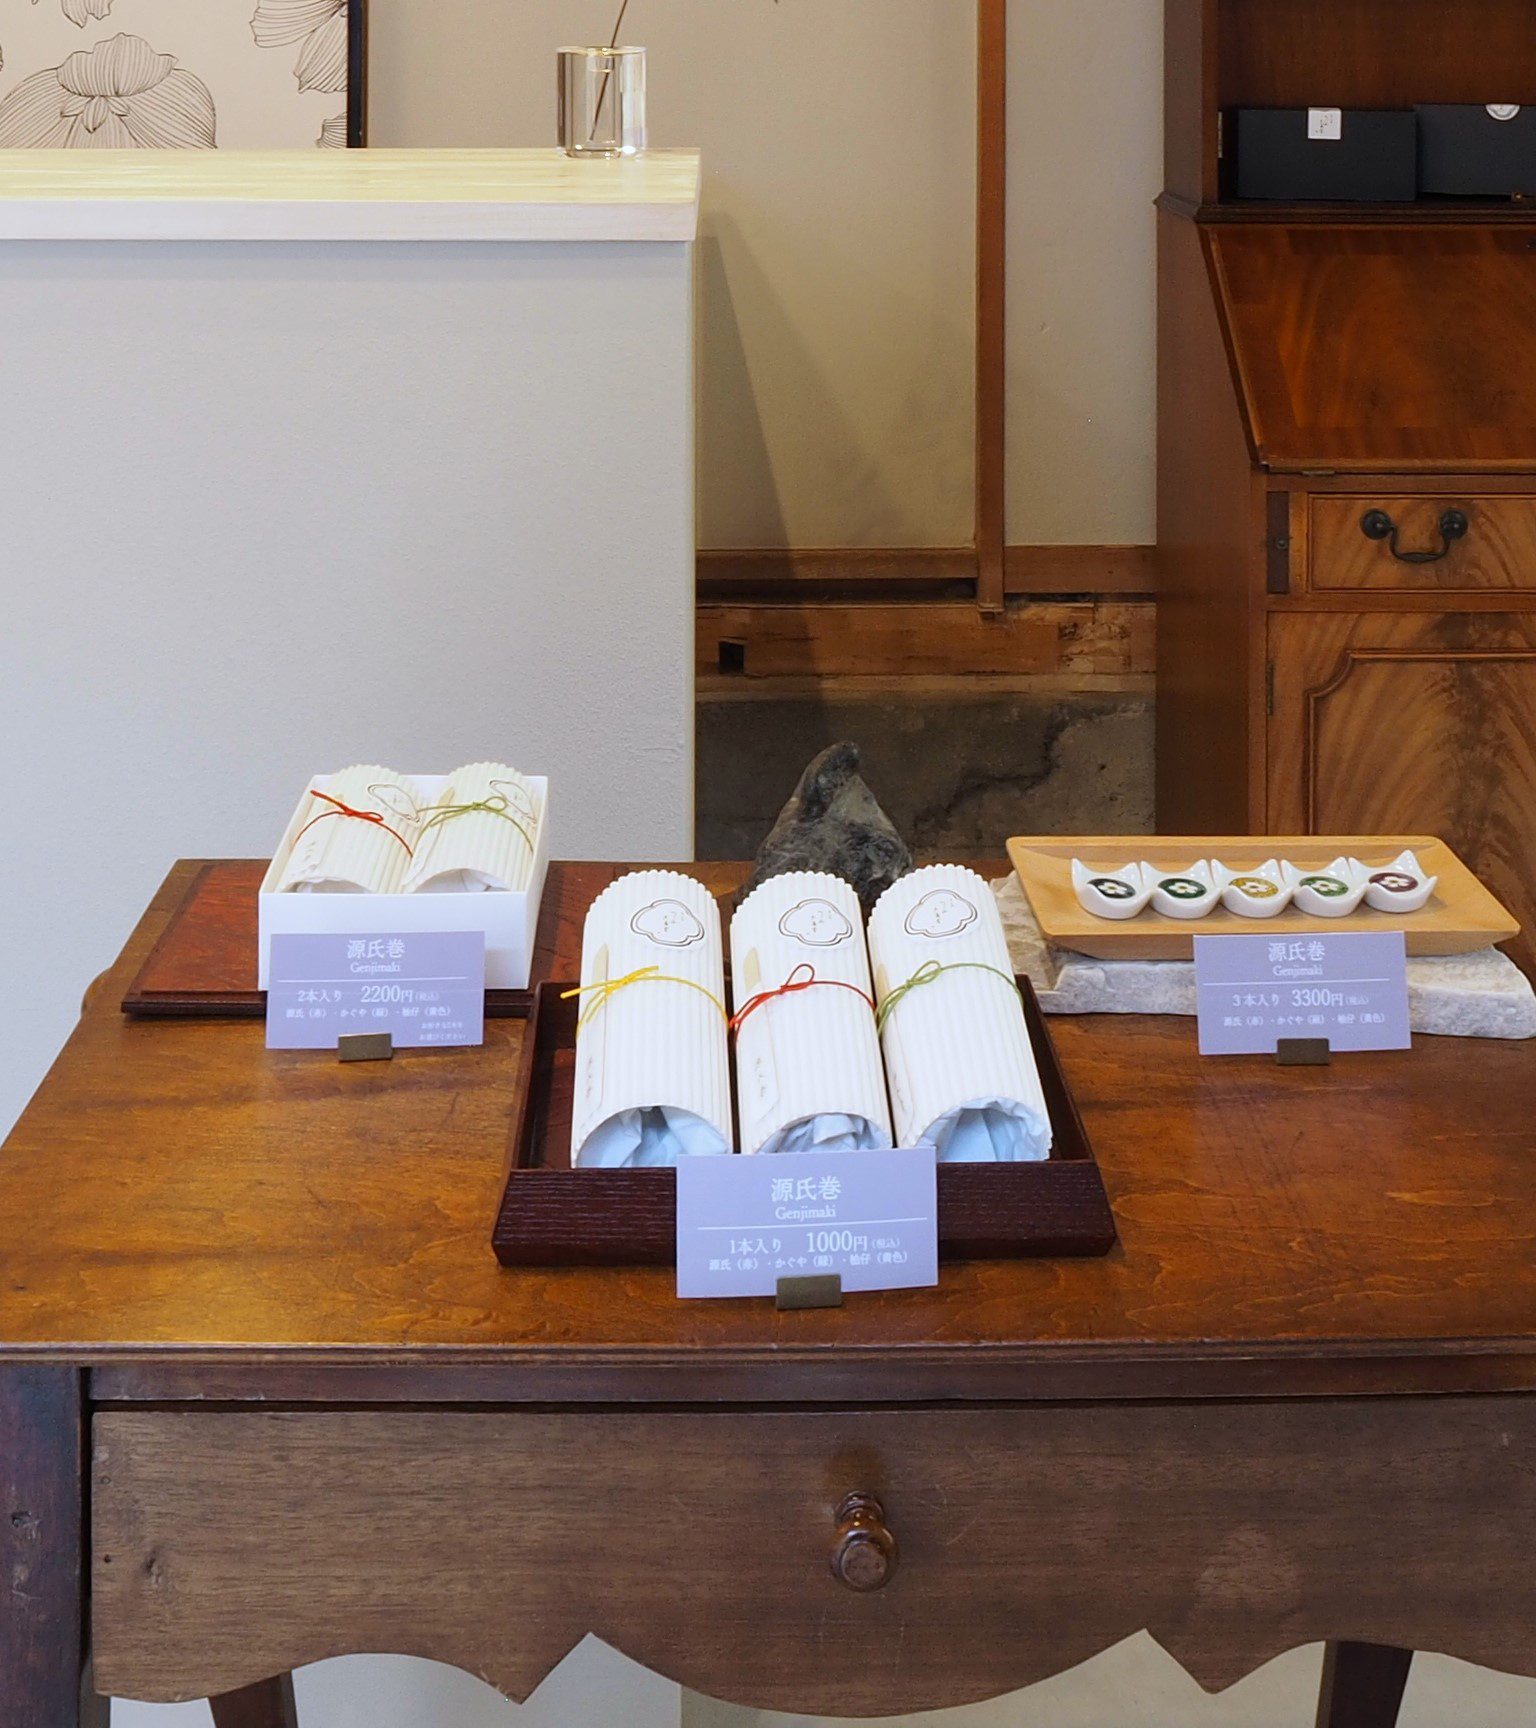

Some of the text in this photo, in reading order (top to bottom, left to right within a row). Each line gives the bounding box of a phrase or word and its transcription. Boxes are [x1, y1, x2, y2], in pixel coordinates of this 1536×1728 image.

[347, 939, 405, 959] 源氏巻
[1268, 941, 1325, 962] 源氏巻
[350, 962, 401, 976] Genjimaki
[1273, 964, 1323, 978] Genjimaki
[297, 989, 342, 1003] 2本入り
[771, 1176, 841, 1202] 源氏巻
[775, 1206, 836, 1222] Genjimaki
[729, 1238, 782, 1255] 1本入り
